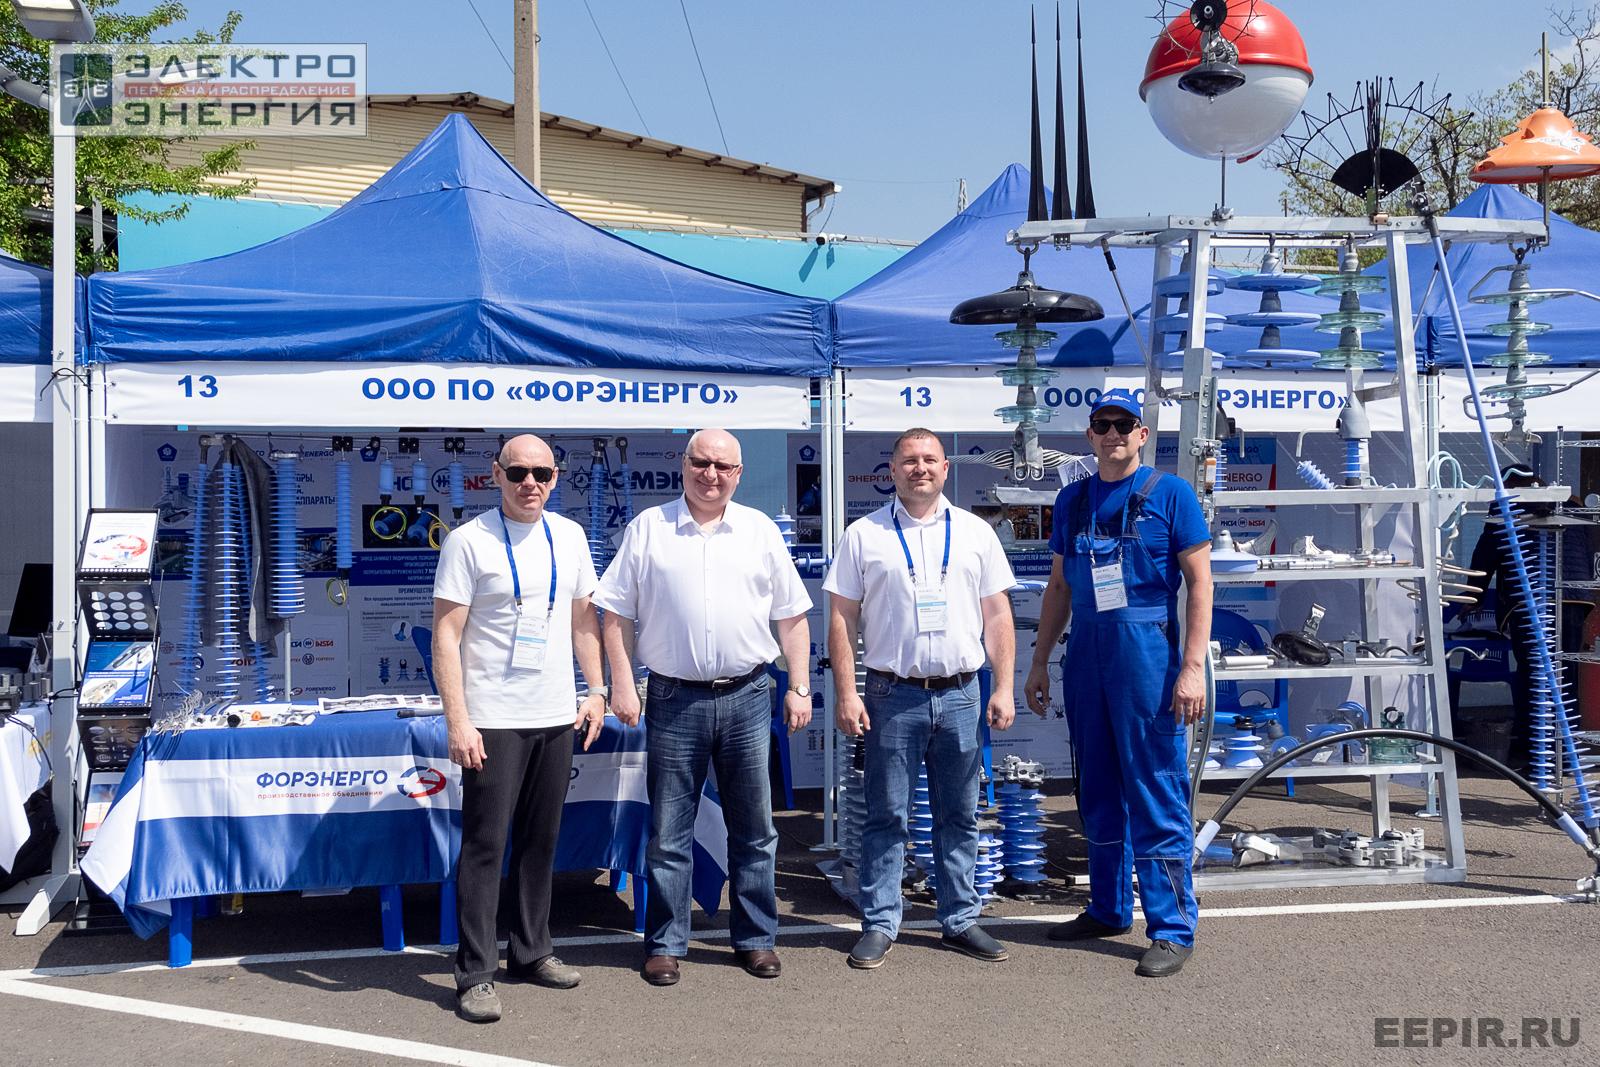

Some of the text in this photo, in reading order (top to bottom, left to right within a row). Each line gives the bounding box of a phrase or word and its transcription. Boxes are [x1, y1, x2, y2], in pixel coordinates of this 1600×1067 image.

[177, 374, 219, 398] 13
[361, 377, 739, 404] ООО ПО «ФОРЭНЕРГО»
[898, 386, 932, 407] 13
[256, 769, 388, 788] ФОРЭНЕРГО
[332, 790, 383, 798] объединение
